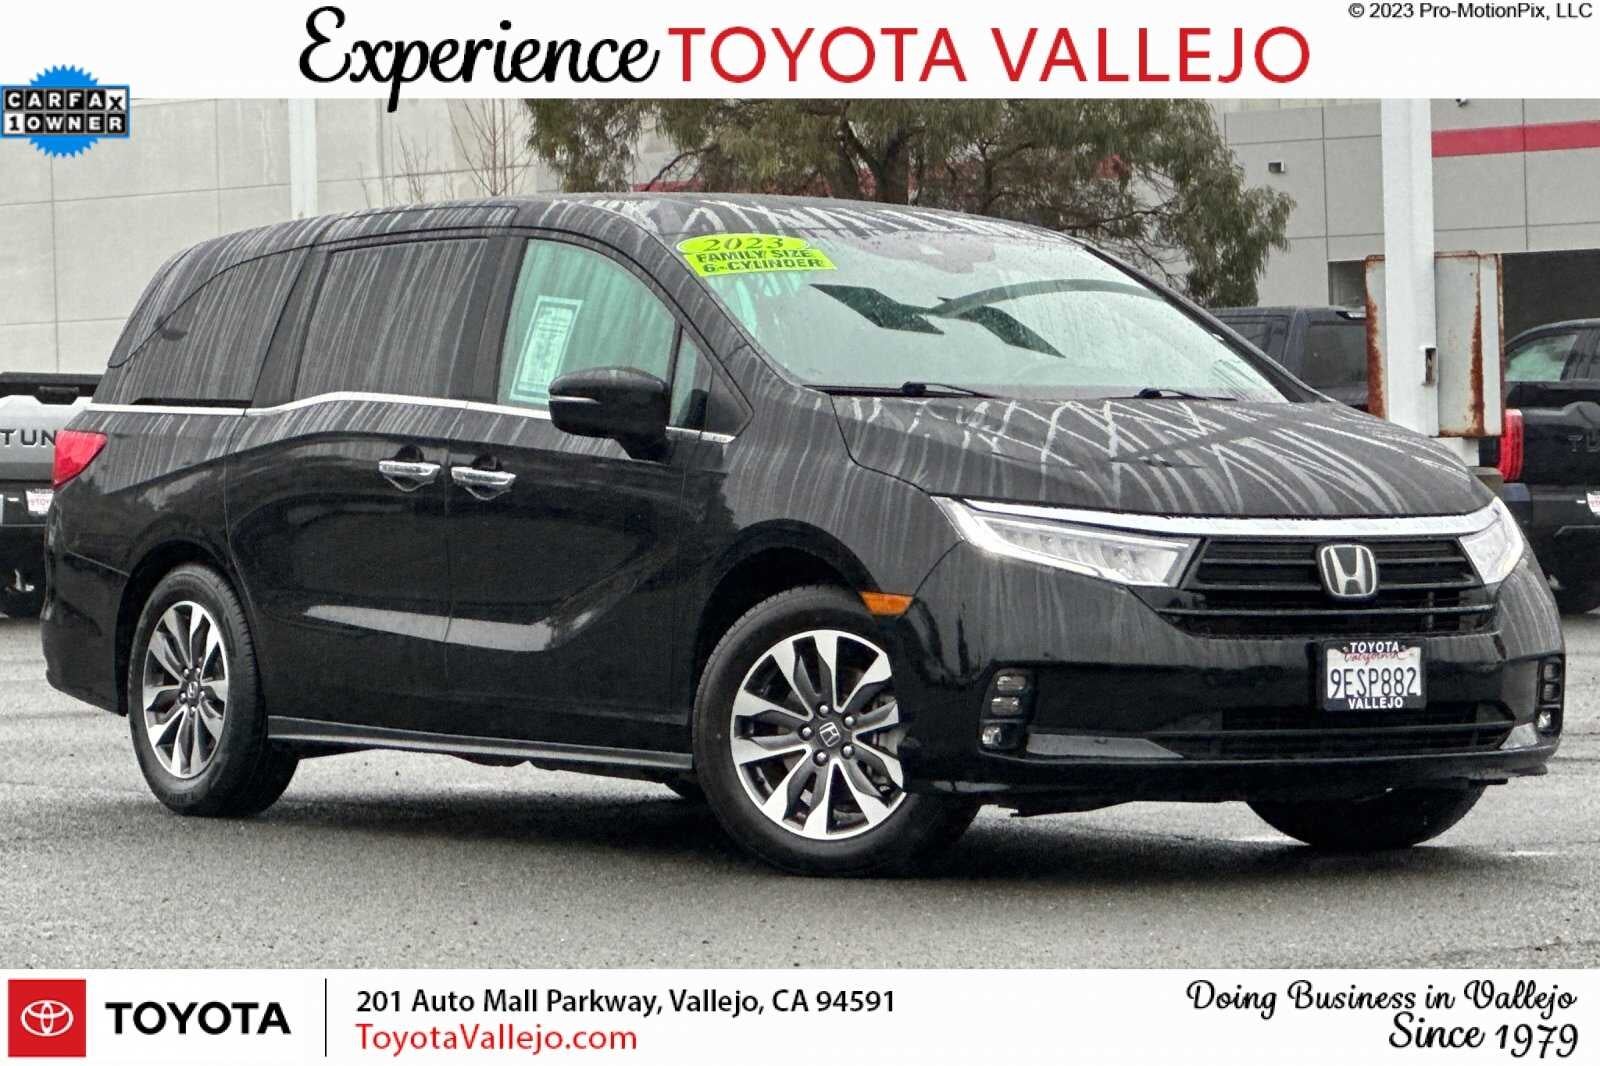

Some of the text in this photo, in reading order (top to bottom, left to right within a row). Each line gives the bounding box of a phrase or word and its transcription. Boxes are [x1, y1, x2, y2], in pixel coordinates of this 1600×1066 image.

[704, 238, 784, 251] 2023
[696, 249, 812, 263] FAMILY SIZE
[703, 258, 822, 273] 6-CYLINDER
[1350, 641, 1399, 653] TOYOTA
[1330, 667, 1417, 699] 9ESP882
[1348, 697, 1404, 709] VALLEJO
